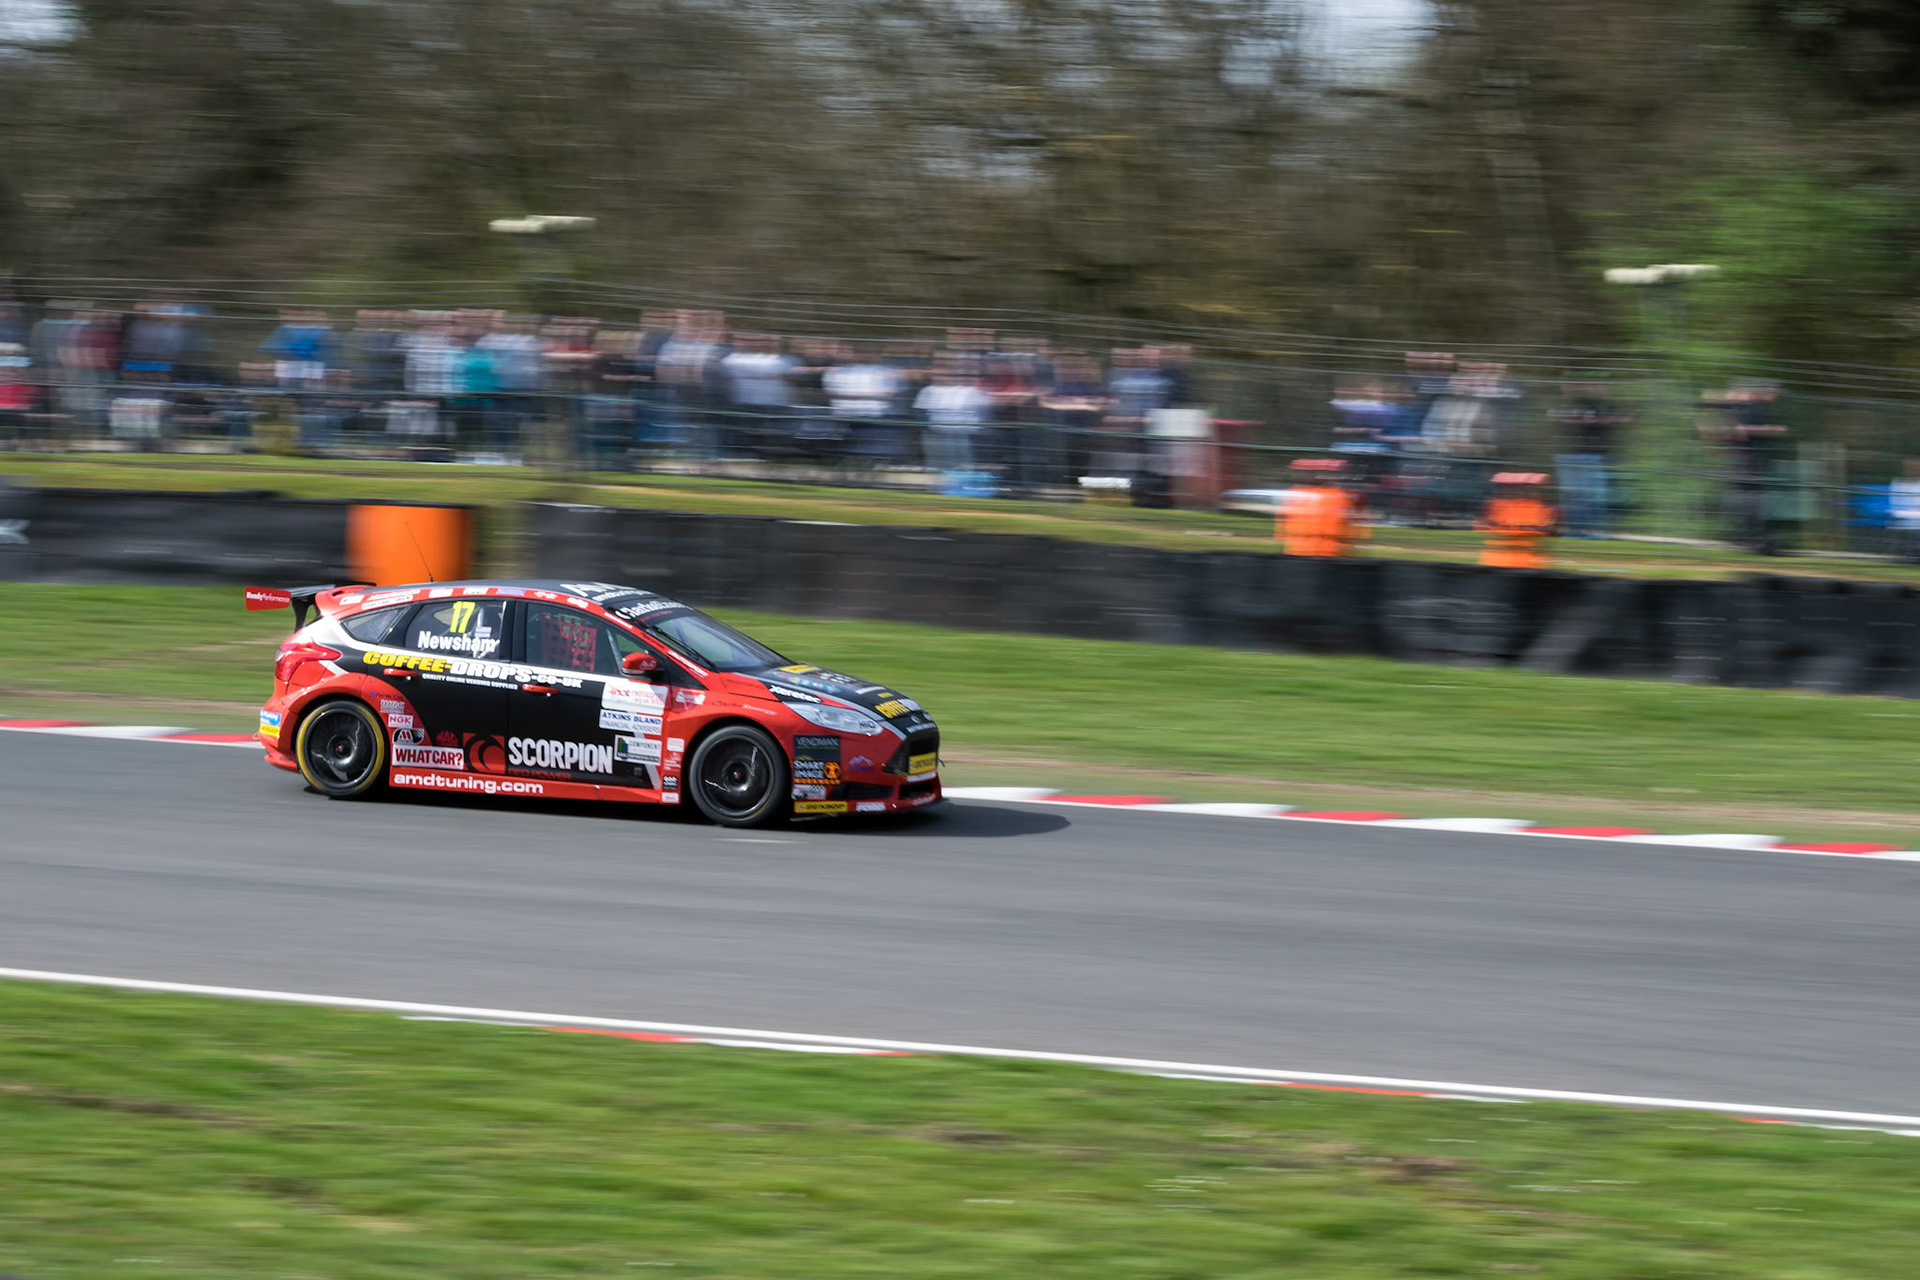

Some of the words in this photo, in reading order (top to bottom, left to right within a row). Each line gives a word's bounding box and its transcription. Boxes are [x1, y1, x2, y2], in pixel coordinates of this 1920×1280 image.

[450, 601, 476, 633] 17
[390, 715, 412, 725] NGK
[602, 711, 631, 721] ATKINS
[633, 715, 661, 725] BLAND
[508, 737, 614, 774] SCORPION
[394, 773, 544, 794] amdtuning.com
